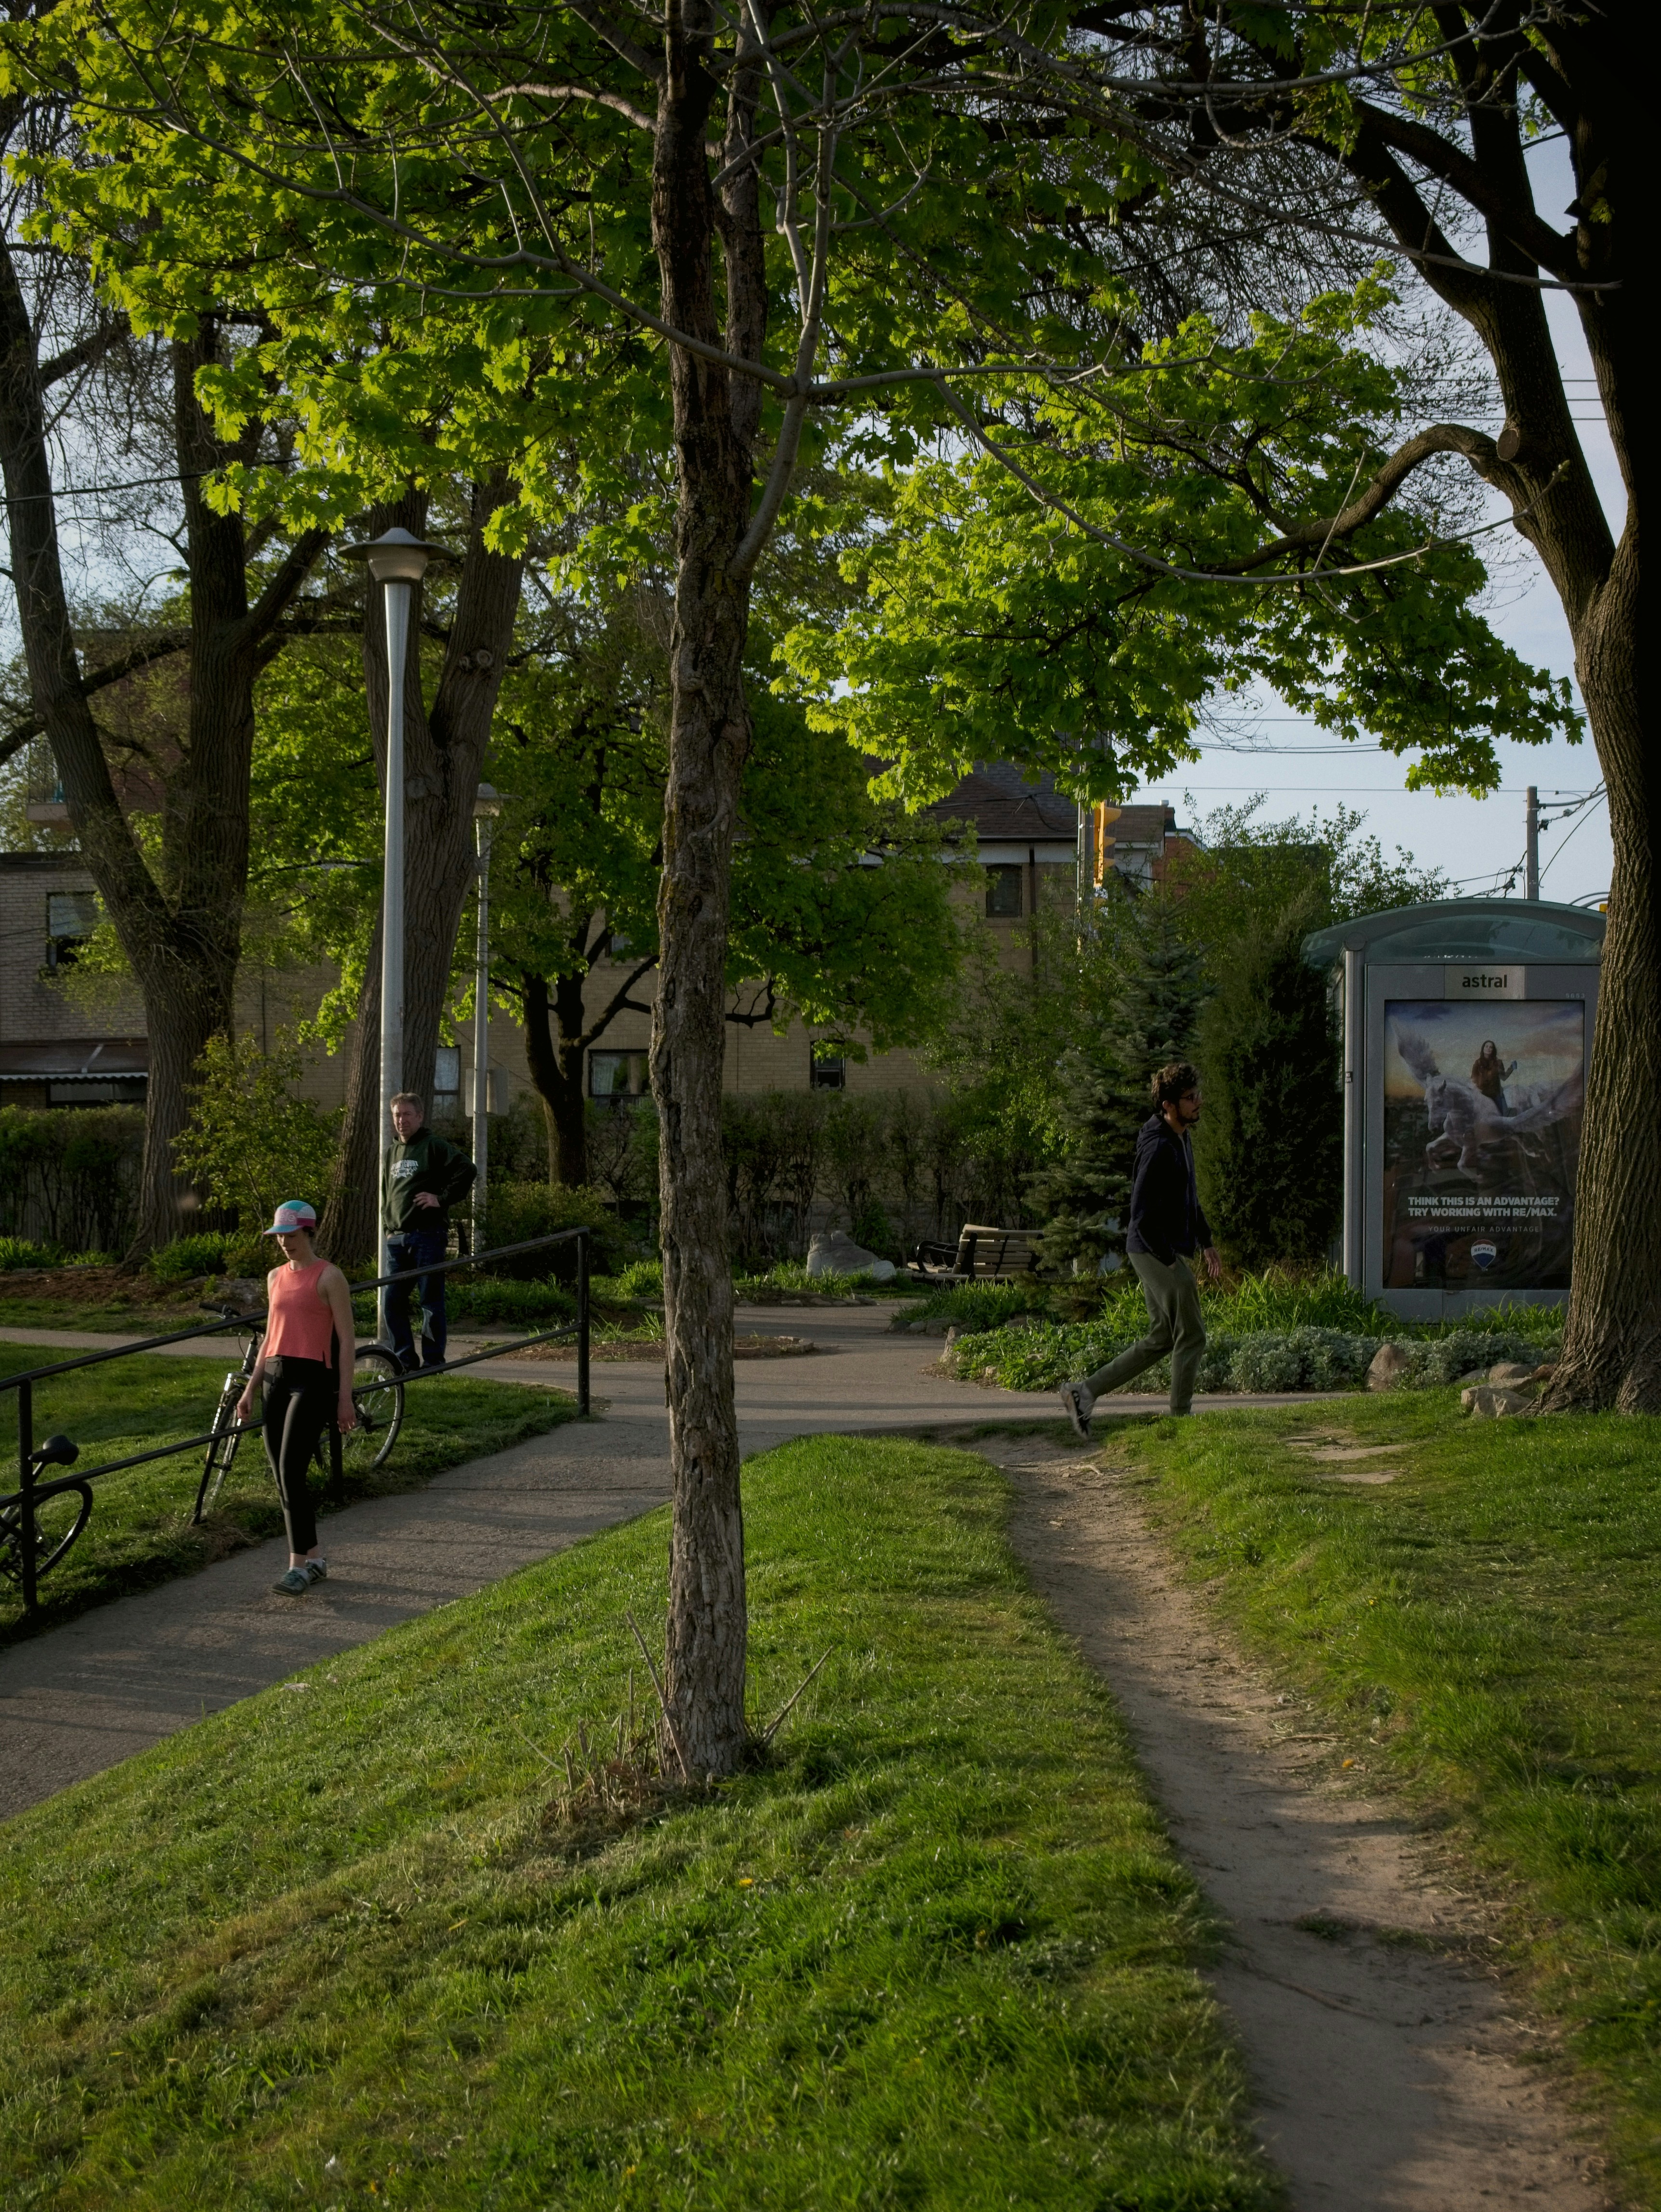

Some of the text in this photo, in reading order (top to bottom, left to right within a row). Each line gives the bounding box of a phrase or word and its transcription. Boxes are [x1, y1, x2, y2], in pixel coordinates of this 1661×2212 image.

[1462, 974, 1507, 988] astral
[1408, 1197, 1560, 1205] THINK THIS IS AN ADVANTAGE?
[1408, 1207, 1557, 1217] TRY WORKING WITH RE/MAX.
